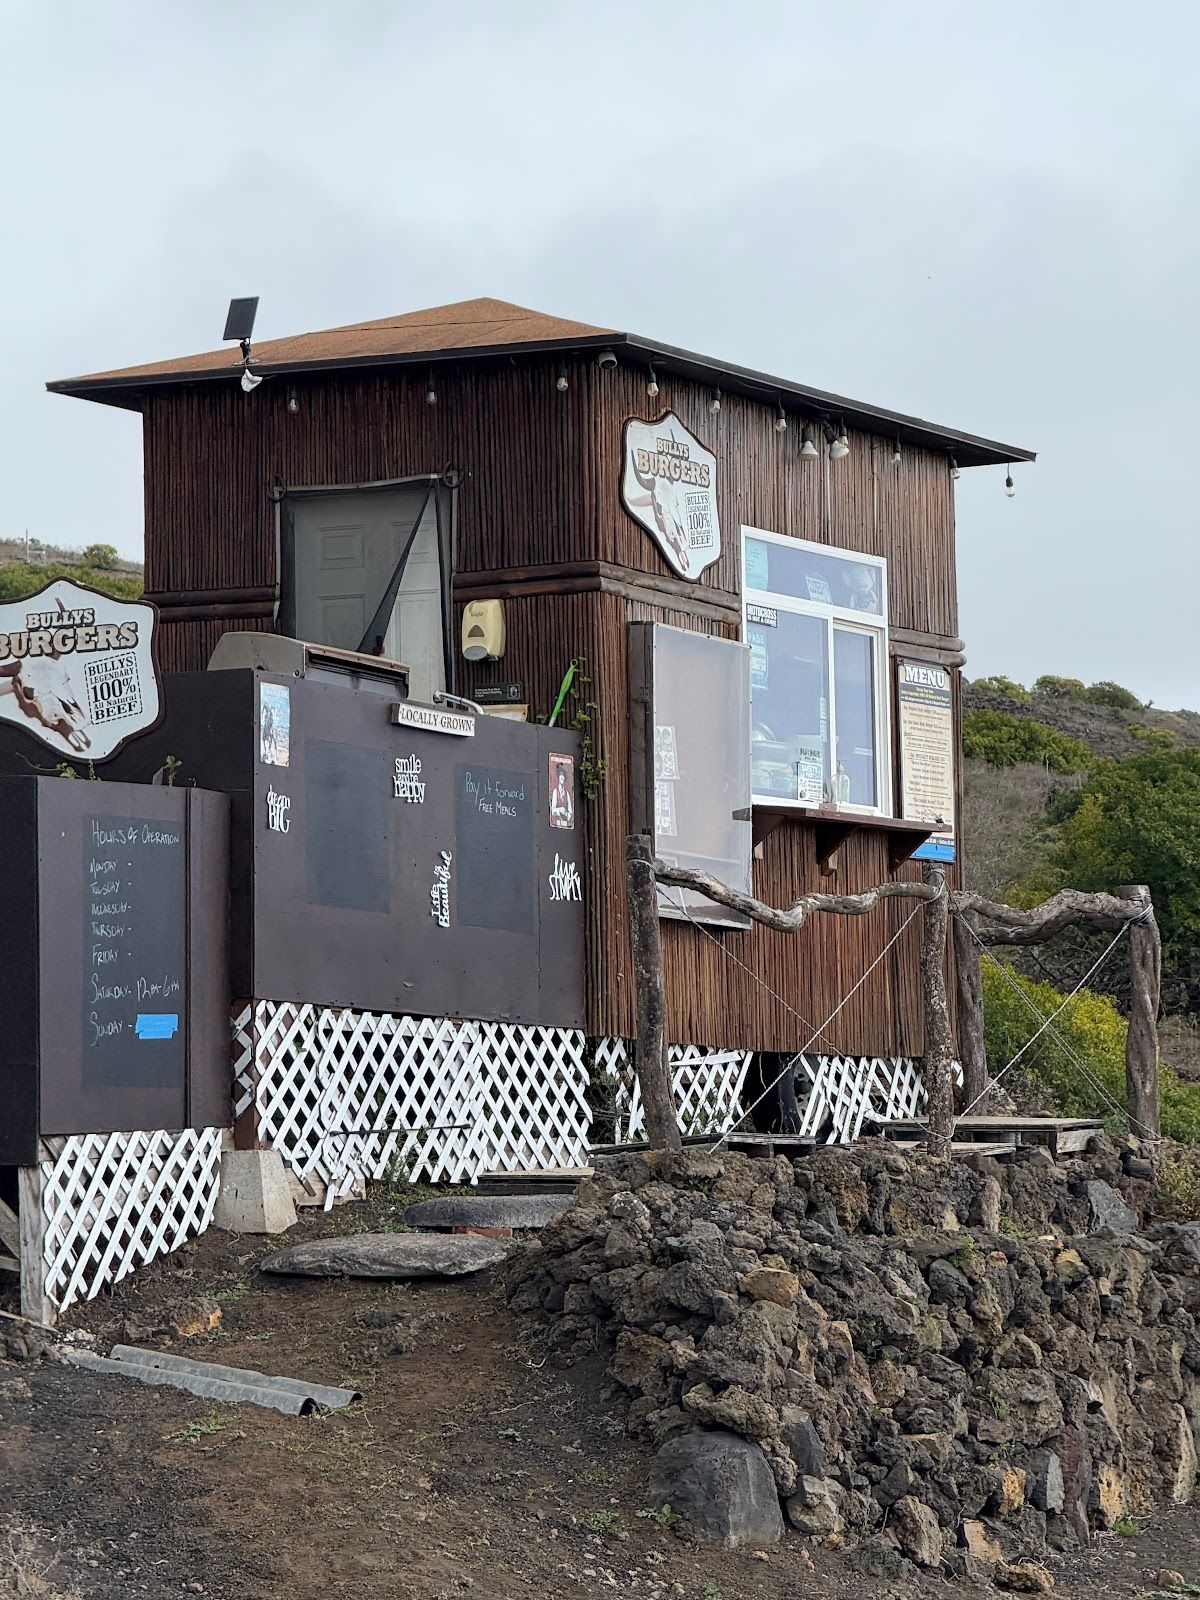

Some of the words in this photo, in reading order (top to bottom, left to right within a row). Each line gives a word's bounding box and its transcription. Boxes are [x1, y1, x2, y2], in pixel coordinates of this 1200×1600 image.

[656, 437, 689, 460] BULLYS
[637, 448, 711, 488] BURGERS
[687, 495, 709, 505] BULLYS
[689, 512, 710, 530] 100%
[690, 535, 711, 545] BEEF
[26, 607, 96, 631] BULLYS
[88, 656, 134, 677] BULLYS
[90, 667, 135, 685] LEGENDARY
[904, 665, 945, 688] MENU
[91, 676, 137, 703] 100%
[107, 693, 138, 706] Natural
[94, 701, 138, 721] BEEF
[401, 707, 440, 727] LOCALLY
[440, 715, 473, 733] GROWN
[395, 753, 422, 774] smile
[267, 784, 291, 810] dream
[392, 775, 426, 804] happy
[465, 771, 480, 806] Pay
[484, 777, 492, 794] it
[269, 803, 291, 833] BIG
[479, 797, 493, 813] FREE
[495, 801, 517, 817] MEALS
[91, 819, 127, 848] HOURS
[141, 823, 180, 846] OPERATION
[431, 883, 441, 918] Life
[438, 850, 453, 929] Beautiful
[92, 943, 119, 967] FRIDAY
